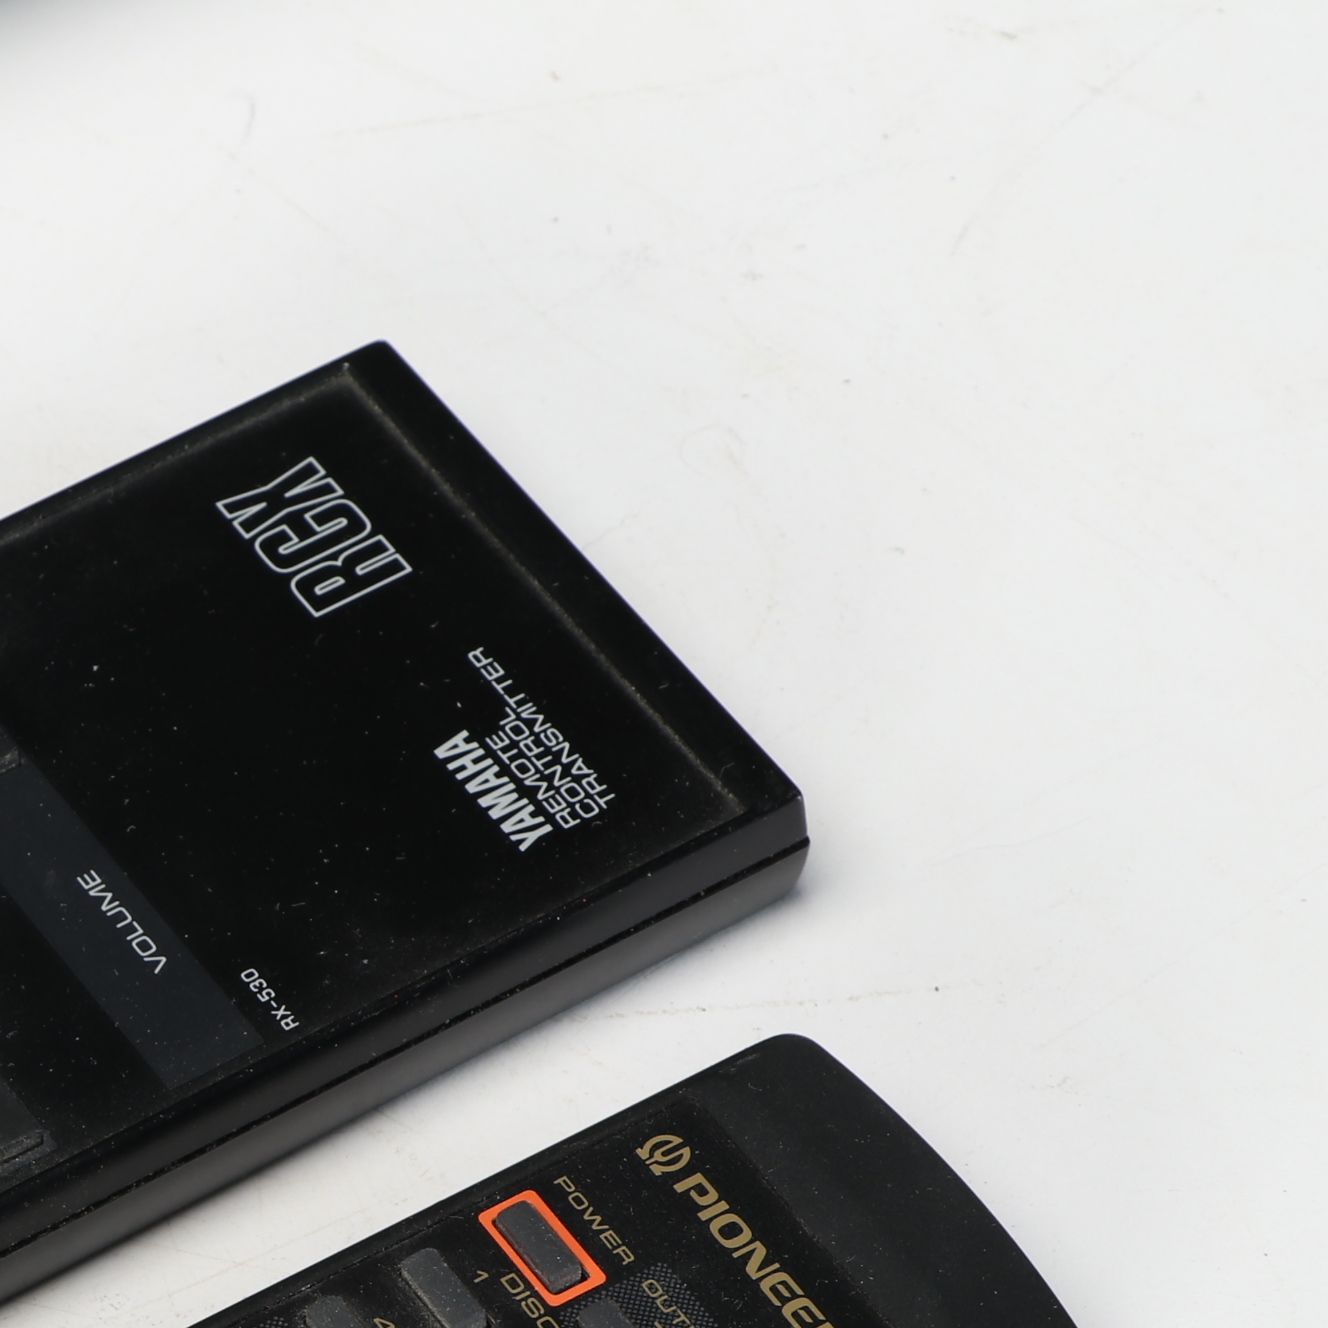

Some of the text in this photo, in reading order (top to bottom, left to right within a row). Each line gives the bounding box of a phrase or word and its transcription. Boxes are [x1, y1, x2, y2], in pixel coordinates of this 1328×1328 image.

[215, 456, 413, 618] RCX
[468, 646, 615, 809] TRANSMITTER
[498, 706, 600, 820] CONTROL
[433, 730, 553, 852] YAMAHA
[485, 734, 581, 830] REMOTE
[77, 870, 167, 975] VOLUME
[240, 968, 300, 1032] RX-530
[553, 1175, 635, 1266] POWER
[473, 1270, 489, 1284] 1
